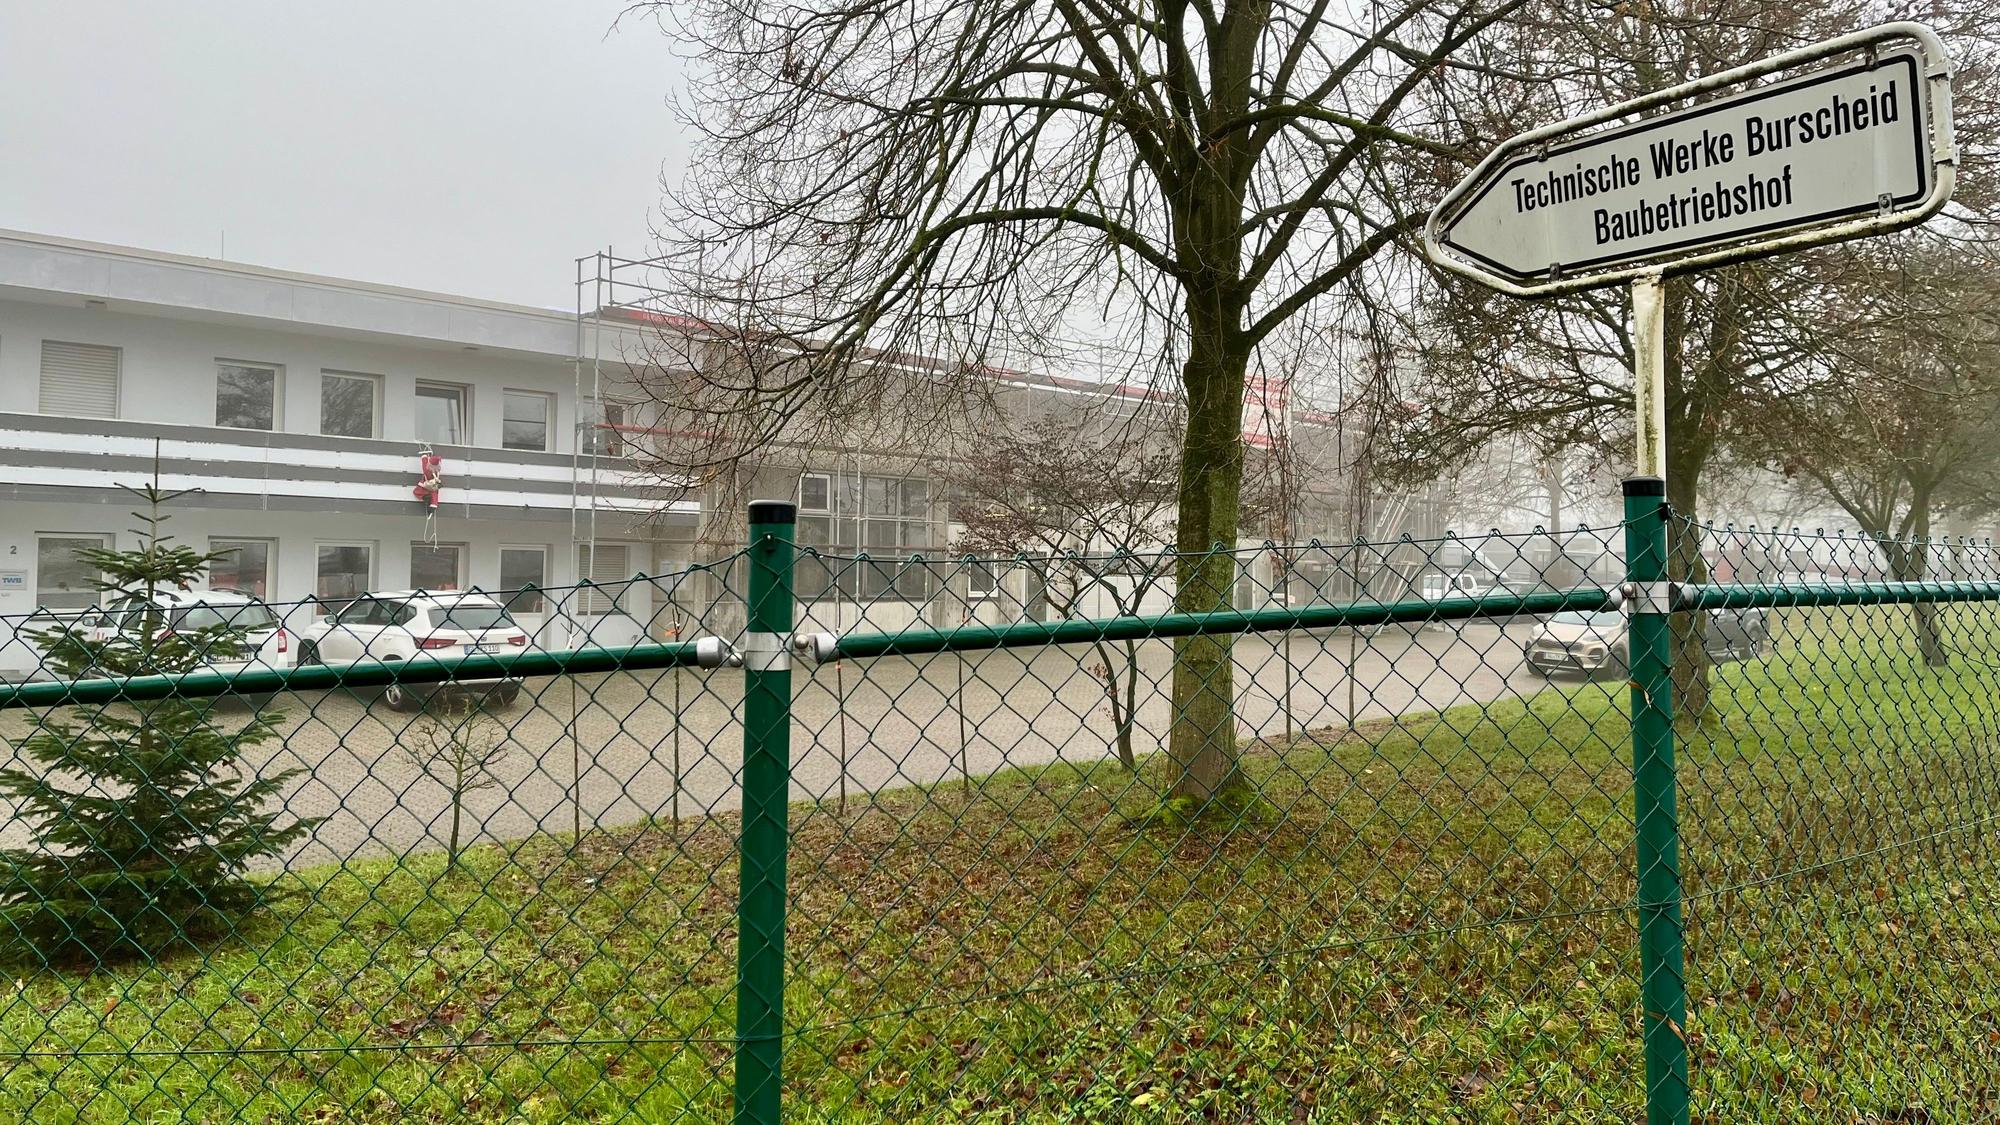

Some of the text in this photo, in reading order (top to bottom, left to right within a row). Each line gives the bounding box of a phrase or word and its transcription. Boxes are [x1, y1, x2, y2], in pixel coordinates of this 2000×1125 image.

[1511, 80, 1899, 214] Technische Werke Burscheid
[1594, 164, 1793, 245] Baubetriebshof
[10, 545, 17, 555] 2
